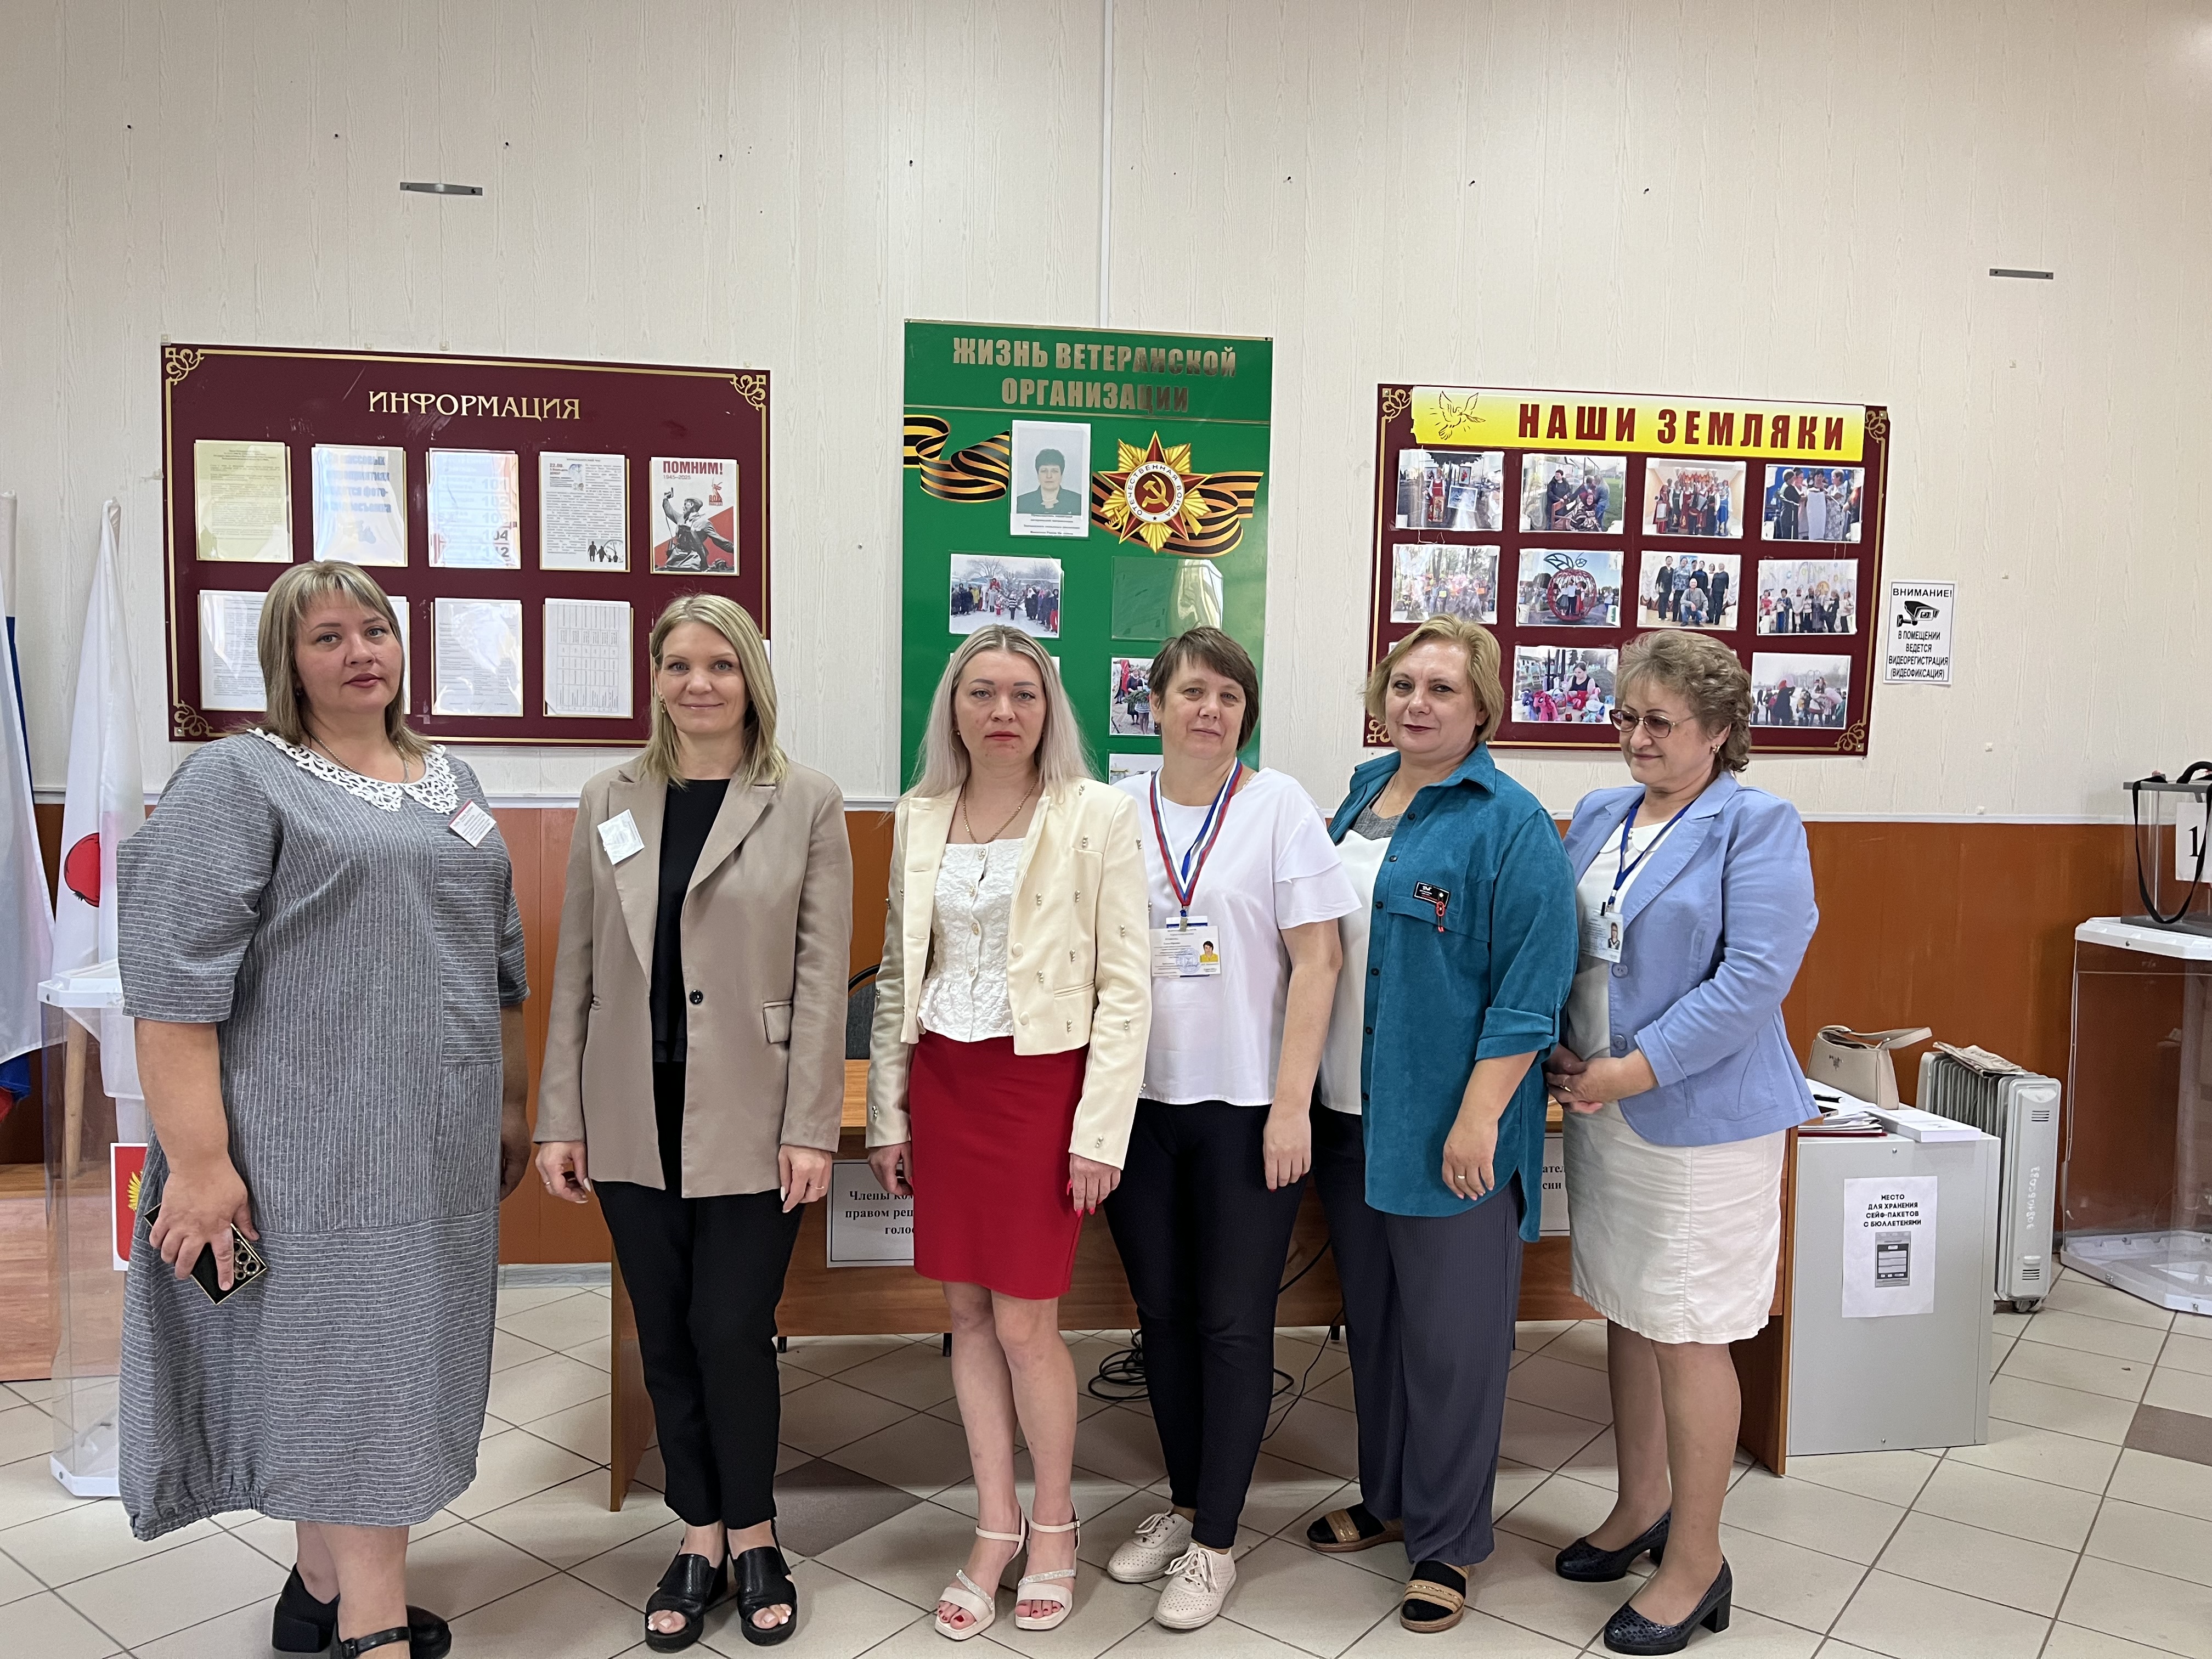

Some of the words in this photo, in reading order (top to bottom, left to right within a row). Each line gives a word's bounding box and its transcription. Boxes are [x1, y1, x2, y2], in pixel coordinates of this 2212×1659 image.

[953, 337, 1048, 368] ЖИЗНЬ
[1056, 342, 1236, 377] ВЕТЕРАНСКОЙ
[1002, 378, 1188, 414] ОРГАНИЗАЦИИ
[368, 391, 580, 422] ИНФОРМАЦИЯ
[1518, 403, 1636, 442] НАШИ
[1657, 409, 1844, 451] ЗЕМЛЯКИ
[663, 461, 723, 475] ПОМНИМ!
[1128, 465, 1178, 516] ОТЕЧЕСТВЕННАЯ
[1893, 588, 1952, 597] ВНИМАНИЕ!
[1898, 630, 1902, 639] В
[1903, 630, 1940, 641] ПОМЕЩЕНИИ
[1905, 644, 1932, 654] ВЕДЕТСЯ
[1888, 656, 1948, 667] ВИДЕОРЕГИСТРАЦИЯ
[1891, 668, 1945, 680] (ВИДЕОФИКСАЦИЯ)
[2188, 826, 2198, 857] 1
[850, 1191, 890, 1200] Члены
[845, 1210, 889, 1220] правом
[1870, 1219, 1921, 1227] БЮЛЛЕТЕНЯМИ
